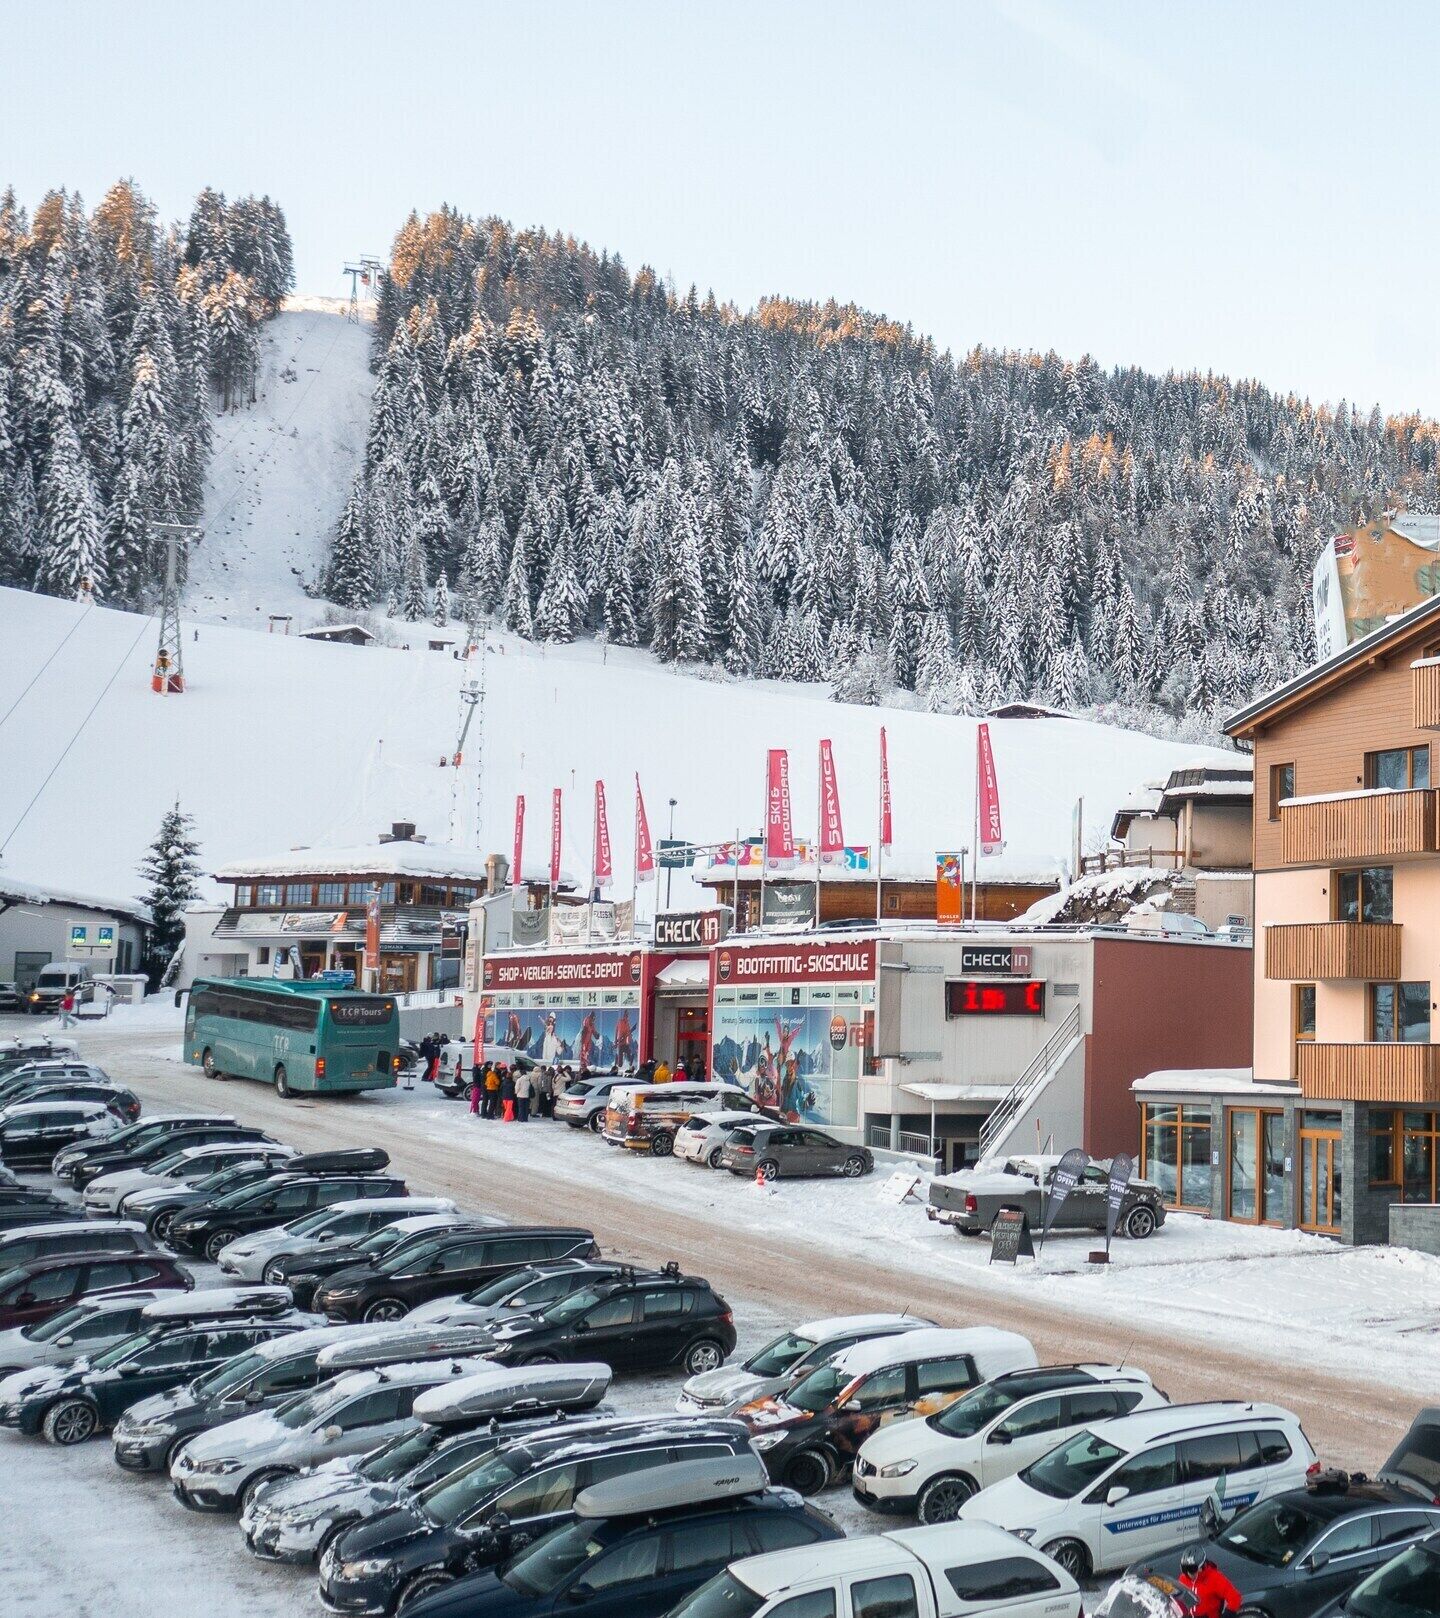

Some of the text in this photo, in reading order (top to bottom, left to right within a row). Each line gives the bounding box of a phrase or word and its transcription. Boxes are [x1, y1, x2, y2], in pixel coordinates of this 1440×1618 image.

[822, 746, 842, 846] SERVICE
[770, 801, 781, 825] SKI
[655, 916, 719, 943] CHECK IN
[962, 953, 1028, 967] CHECK IN
[361, 1008, 382, 1016] Tours
[830, 1024, 847, 1034] SPORT
[831, 1033, 845, 1041] 2000
[1056, 1174, 1075, 1187] OPEN
[1110, 1183, 1126, 1194] OPEN
[1116, 1517, 1149, 1531] Unterwegs
[1150, 1515, 1159, 1524] für
[1159, 1507, 1198, 1522] Jobsuchende
